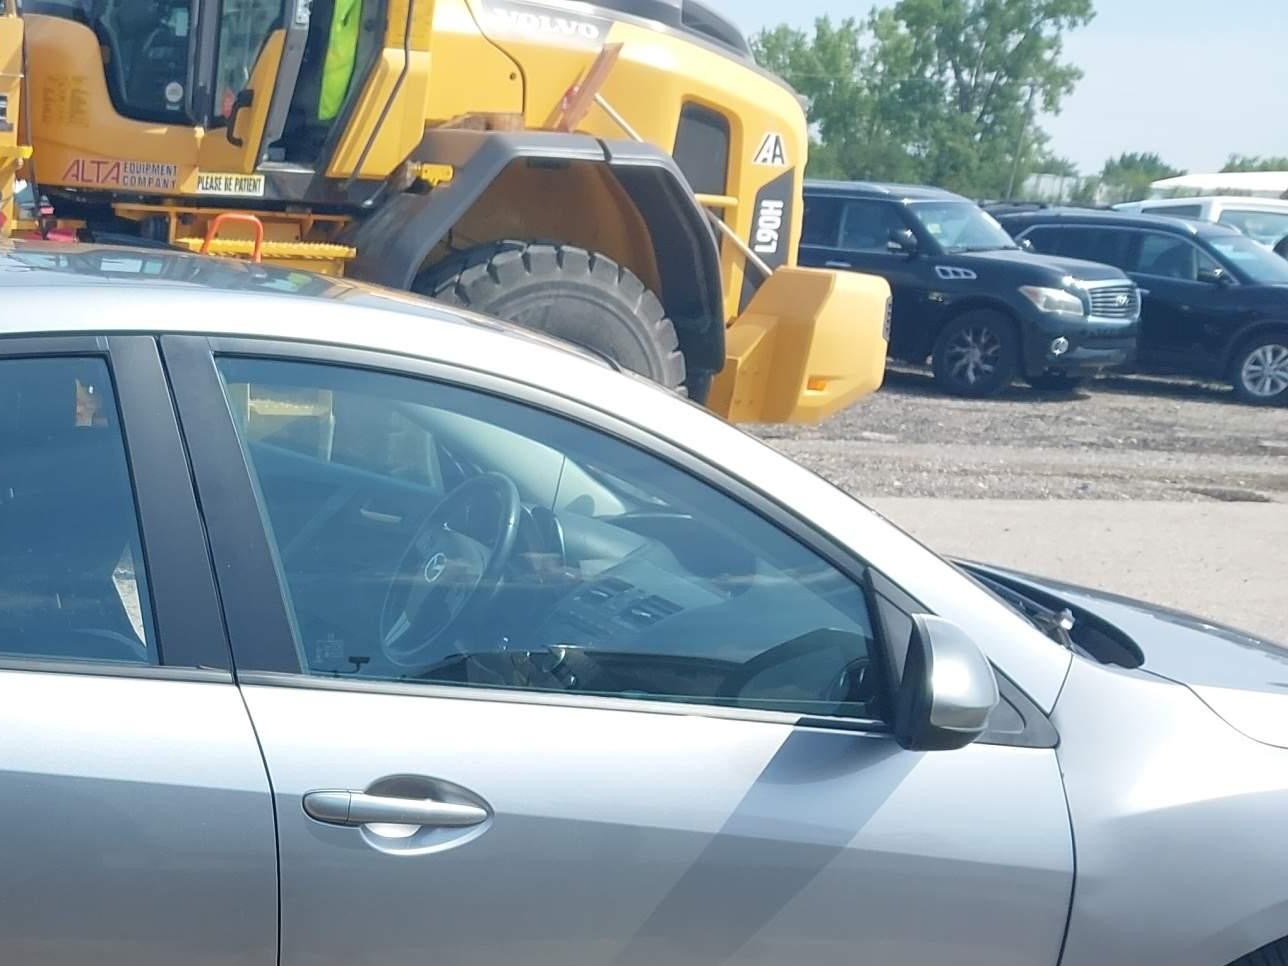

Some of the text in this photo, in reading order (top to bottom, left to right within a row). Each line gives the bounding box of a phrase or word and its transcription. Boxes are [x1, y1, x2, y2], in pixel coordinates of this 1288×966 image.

[492, 7, 600, 40] VOLVO
[62, 159, 121, 184] ALTA
[123, 161, 178, 175] EQUIPMENT
[122, 175, 177, 189] COMPANY
[197, 174, 262, 193] PLEASE BE PATIENT
[753, 199, 785, 253] L90H
